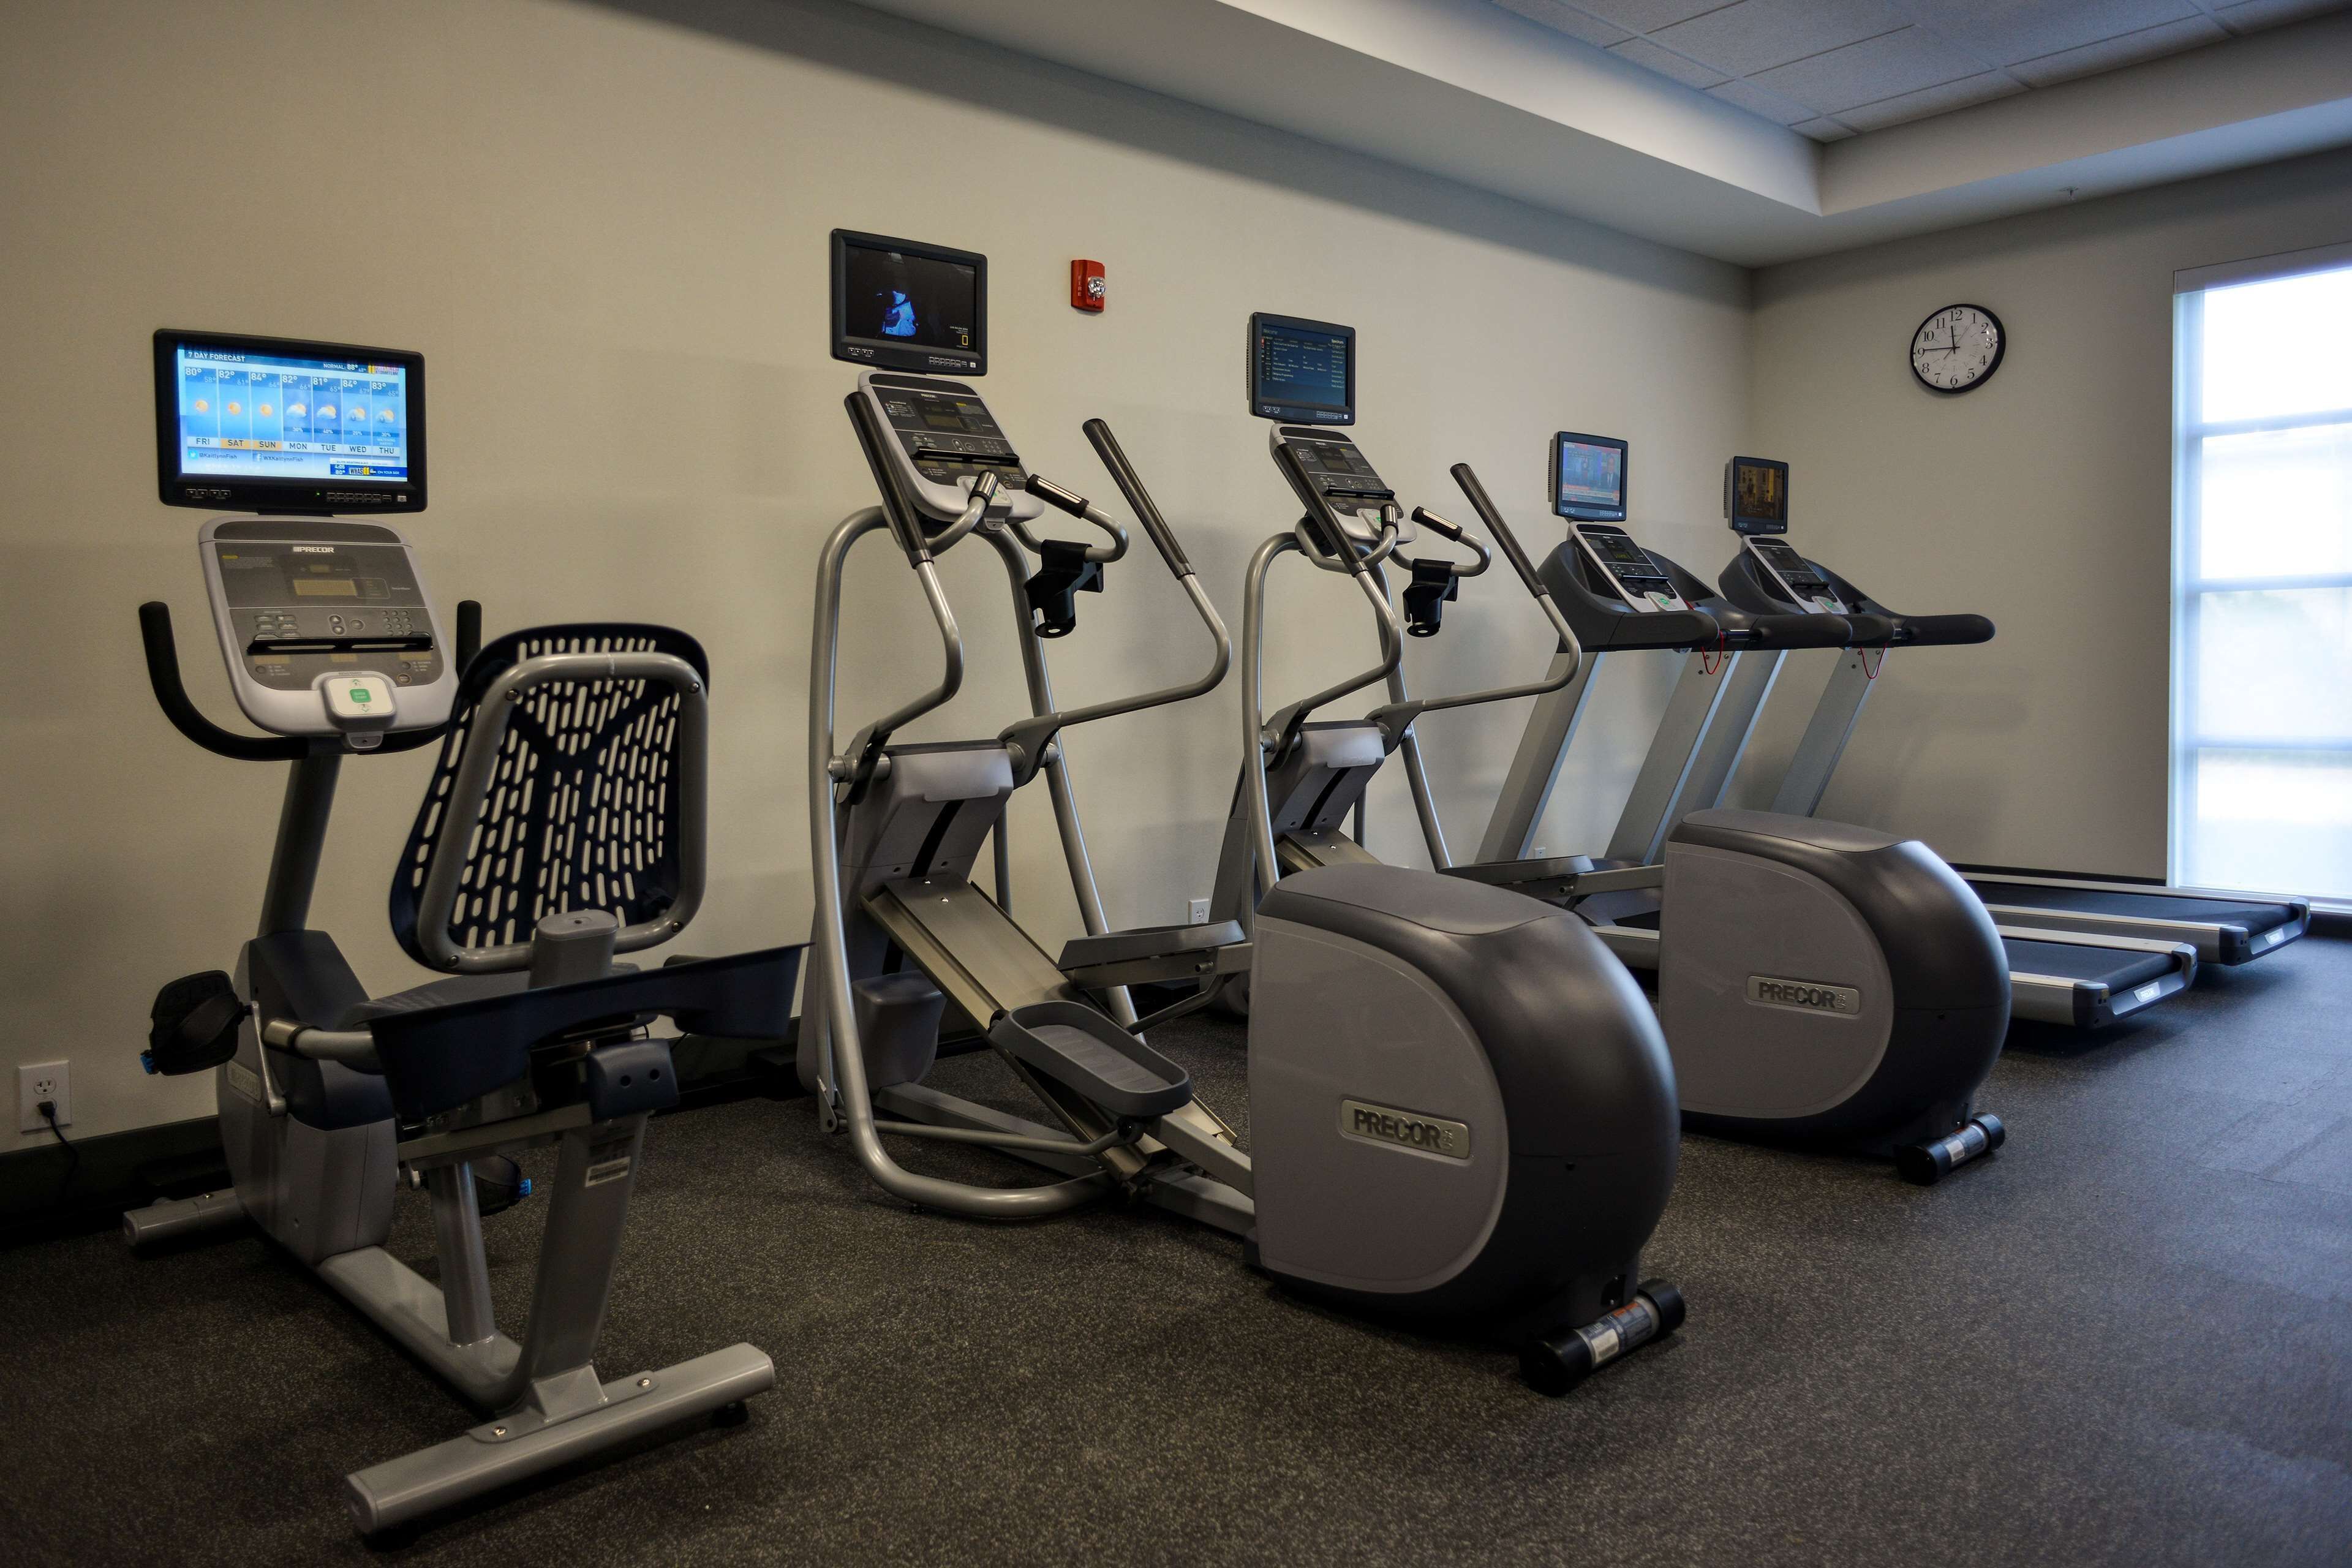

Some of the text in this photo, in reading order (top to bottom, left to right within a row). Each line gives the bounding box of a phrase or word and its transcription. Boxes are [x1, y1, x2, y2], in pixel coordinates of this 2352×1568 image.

[1950, 310, 1963, 322] 12
[1936, 318, 1946, 329] 11
[1981, 322, 1989, 334] 2
[1923, 330, 1934, 342] 10
[209, 353, 246, 362] FORECAST
[1917, 347, 1925, 358] 9
[1979, 355, 1988, 366] 4
[186, 368, 202, 376] 80°
[1921, 363, 1929, 374] 8
[1967, 368, 1975, 379] 5
[219, 370, 235, 379] 82°
[251, 372, 267, 381] 84°
[282, 375, 298, 383] 82°
[1934, 372, 1940, 383] 7
[372, 382, 386, 390] 83°
[1950, 375, 1958, 386] 6
[1758, 982, 1836, 1008] PRECOR
[1354, 1107, 1441, 1148] PRECOR
